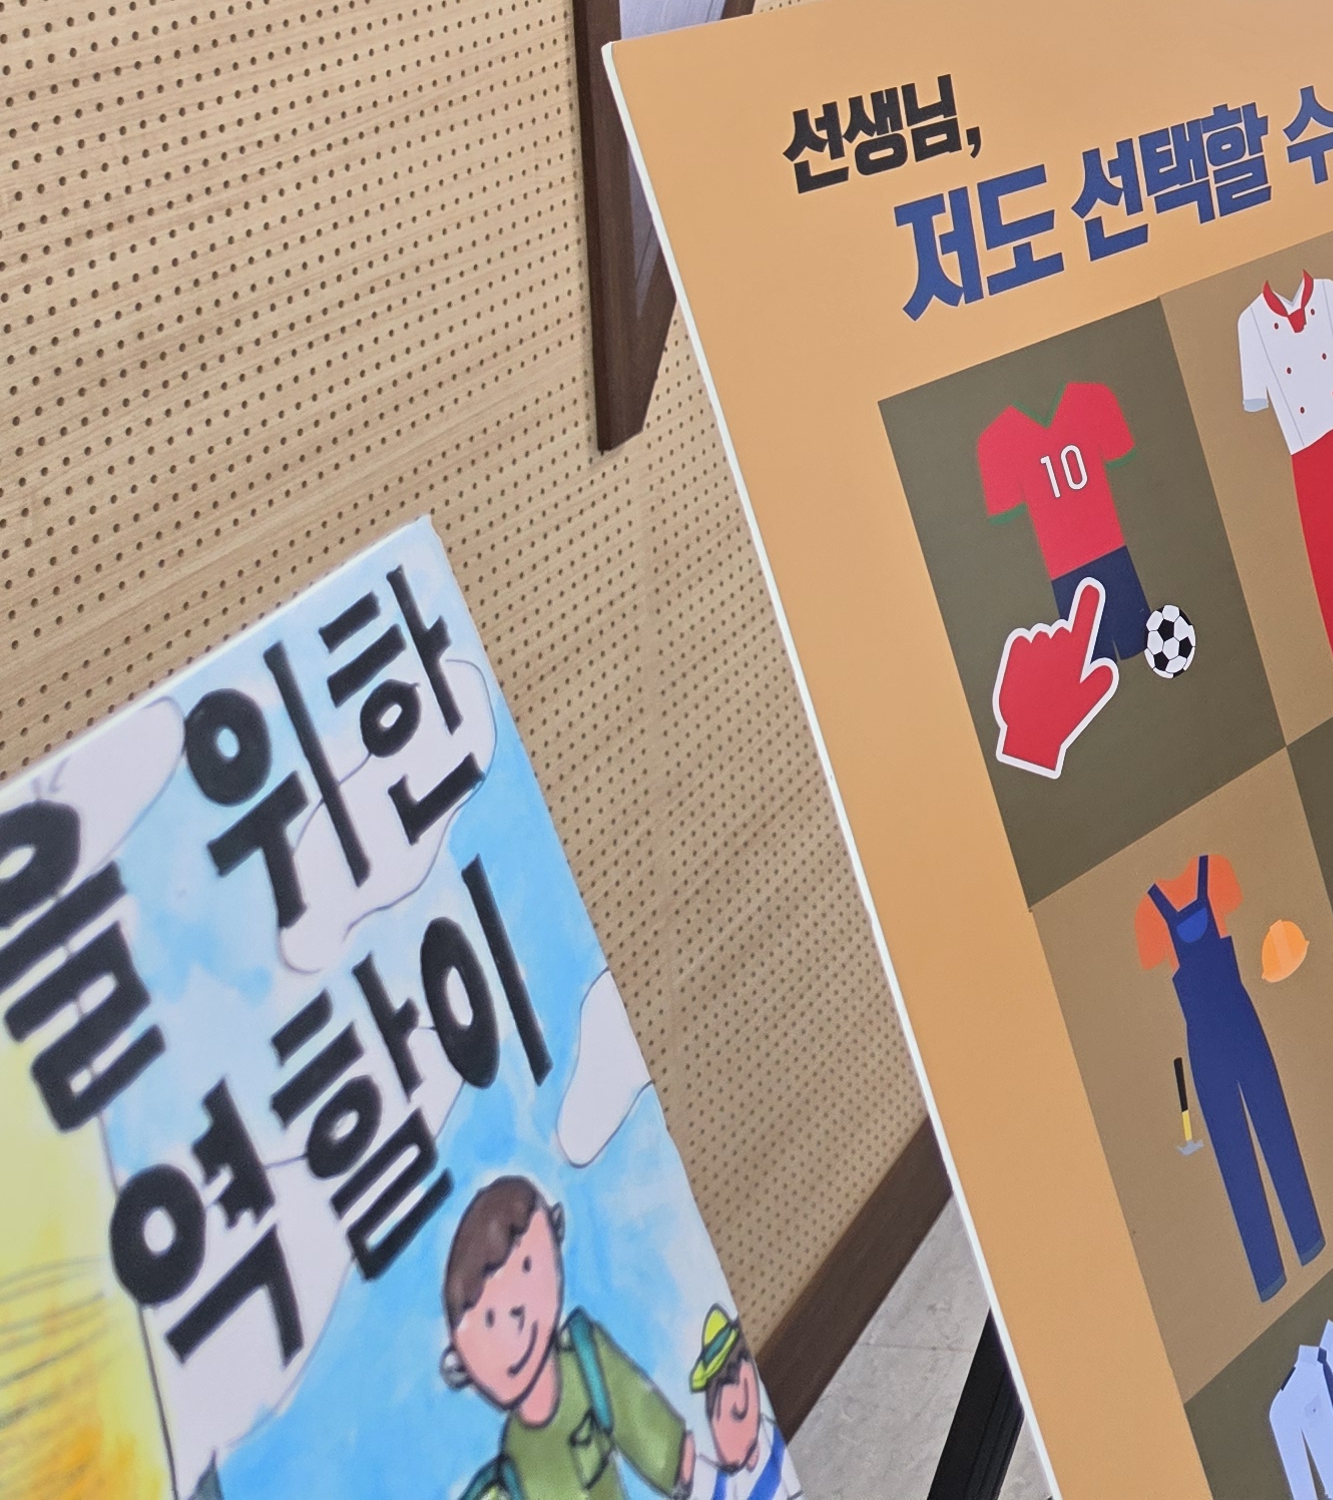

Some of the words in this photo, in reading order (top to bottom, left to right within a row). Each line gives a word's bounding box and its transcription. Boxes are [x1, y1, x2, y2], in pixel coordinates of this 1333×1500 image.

[782, 73, 983, 193] 선생님,
[894, 164, 1065, 322] 저도
[1072, 103, 1271, 262] 선택할
[1040, 443, 1089, 499] 10
[185, 564, 486, 928] 위한
[111, 853, 555, 1369] 역할이
